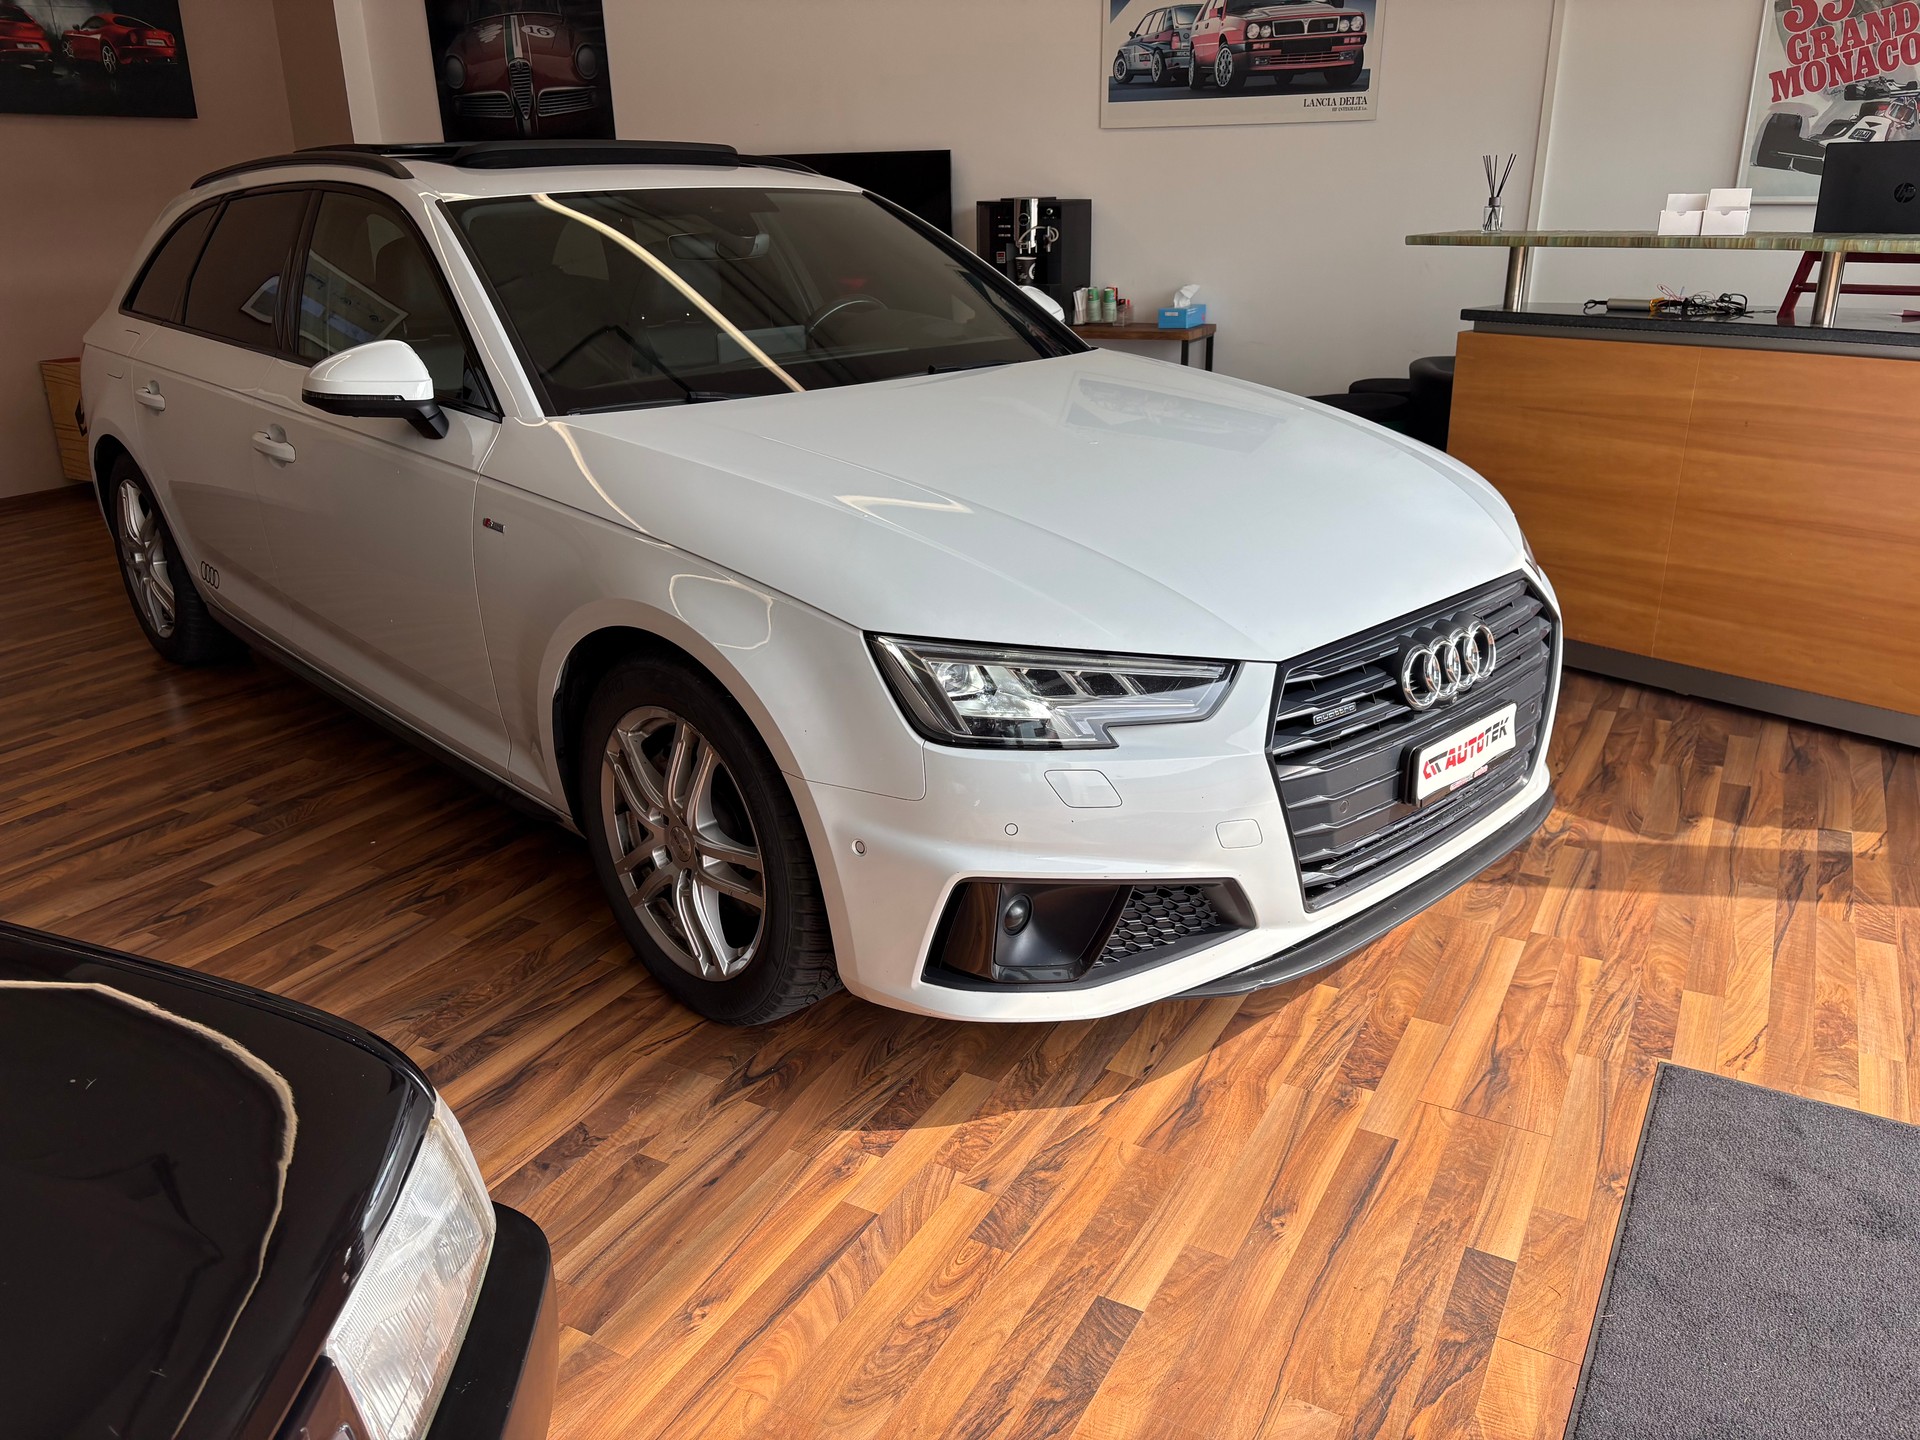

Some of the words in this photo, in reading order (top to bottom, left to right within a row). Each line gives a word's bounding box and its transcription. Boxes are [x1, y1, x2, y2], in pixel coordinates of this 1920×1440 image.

[528, 25, 550, 36] 16
[1786, 2, 1920, 66] GRAND
[1768, 32, 1920, 103] MONACO
[1303, 97, 1337, 108] LANCIA
[1339, 96, 1368, 106] DELTA
[1315, 703, 1356, 723] quattro
[1445, 717, 1510, 770] AUTOTEK
